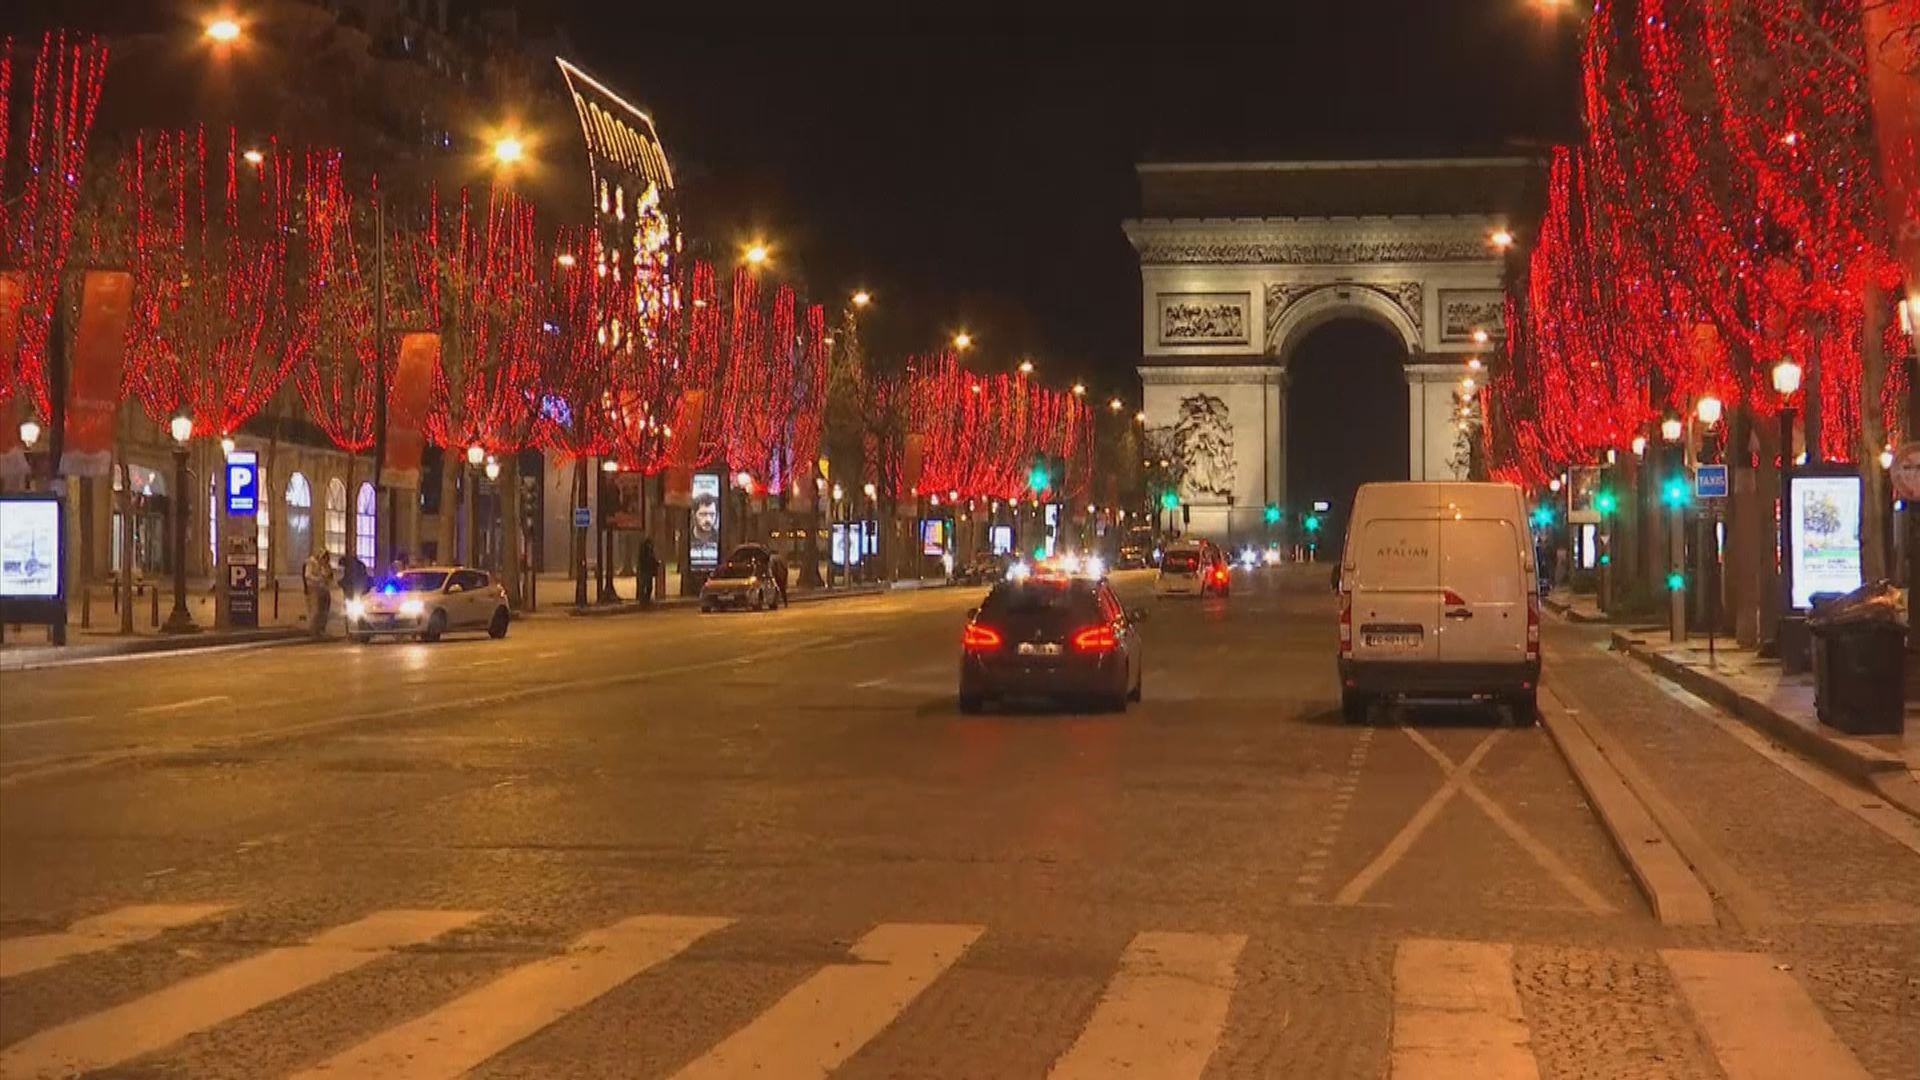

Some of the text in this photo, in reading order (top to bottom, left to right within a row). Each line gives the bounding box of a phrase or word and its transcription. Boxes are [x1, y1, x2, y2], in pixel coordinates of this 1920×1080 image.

[230, 466, 252, 495] P
[1699, 476, 1725, 487] TAXIS
[1376, 547, 1429, 559] ATALIAN
[231, 566, 247, 587] P
